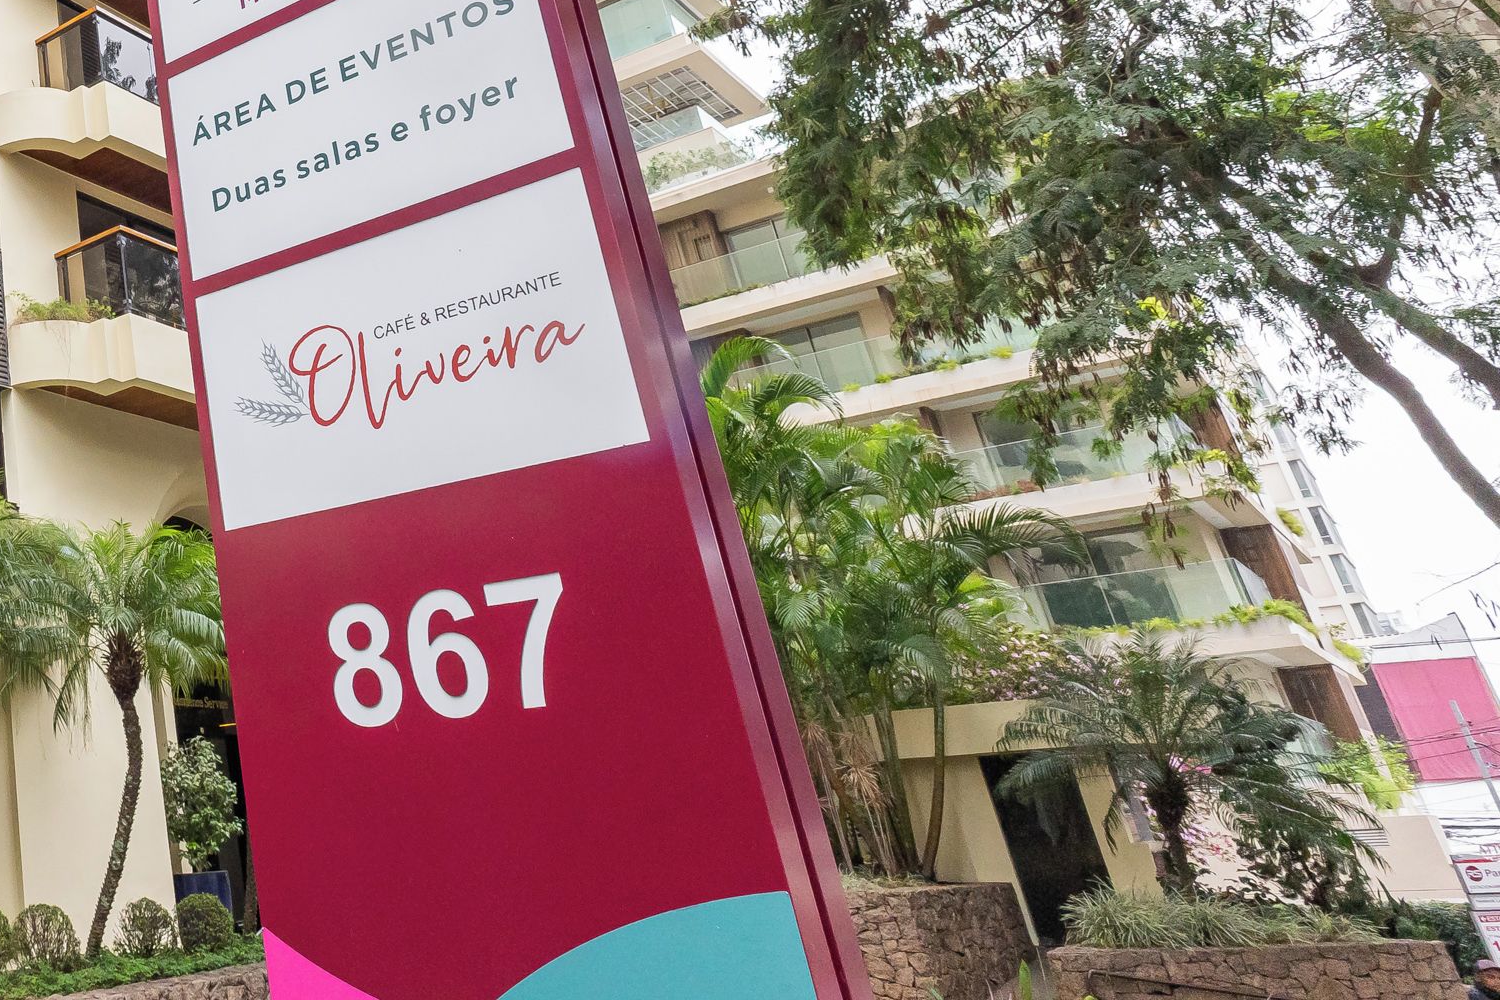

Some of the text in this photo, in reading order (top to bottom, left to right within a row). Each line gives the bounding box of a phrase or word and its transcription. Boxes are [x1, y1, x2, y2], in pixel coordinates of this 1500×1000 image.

[192, 93, 277, 146] ÁREA
[285, 68, 330, 105] DE
[211, 76, 519, 212] Duas salas e foyer
[373, 271, 563, 340] CAFÉ & RESTAURANTE
[289, 320, 586, 430] Oliveira
[328, 571, 564, 728] 867
